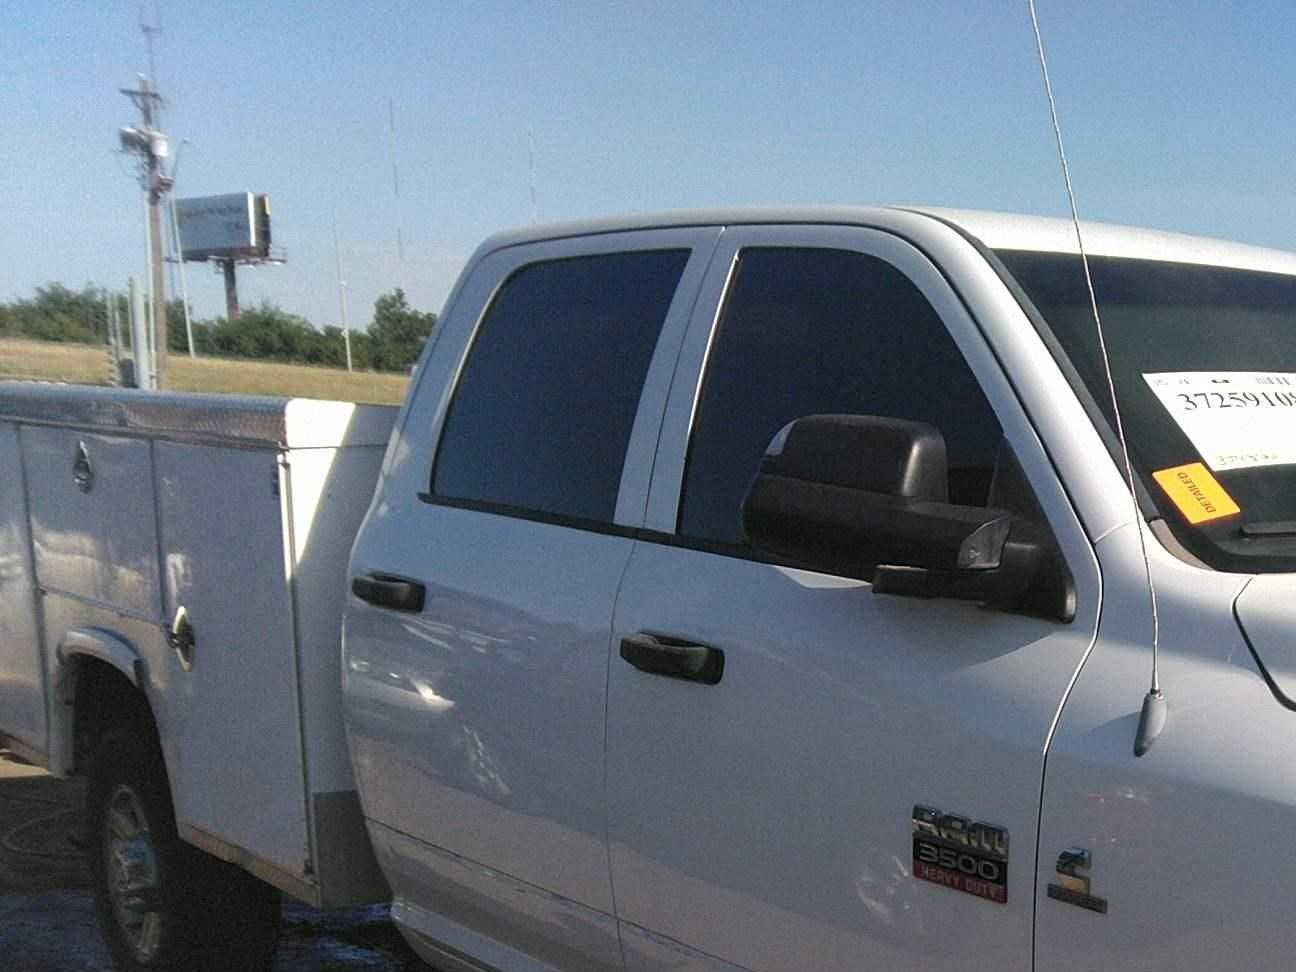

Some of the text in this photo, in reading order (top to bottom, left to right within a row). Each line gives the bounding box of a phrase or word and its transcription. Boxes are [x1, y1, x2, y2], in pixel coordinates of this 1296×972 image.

[1177, 472, 1217, 513] DETAILED
[918, 842, 999, 880] 3500
[920, 865, 997, 899] HEAVY DUTY
